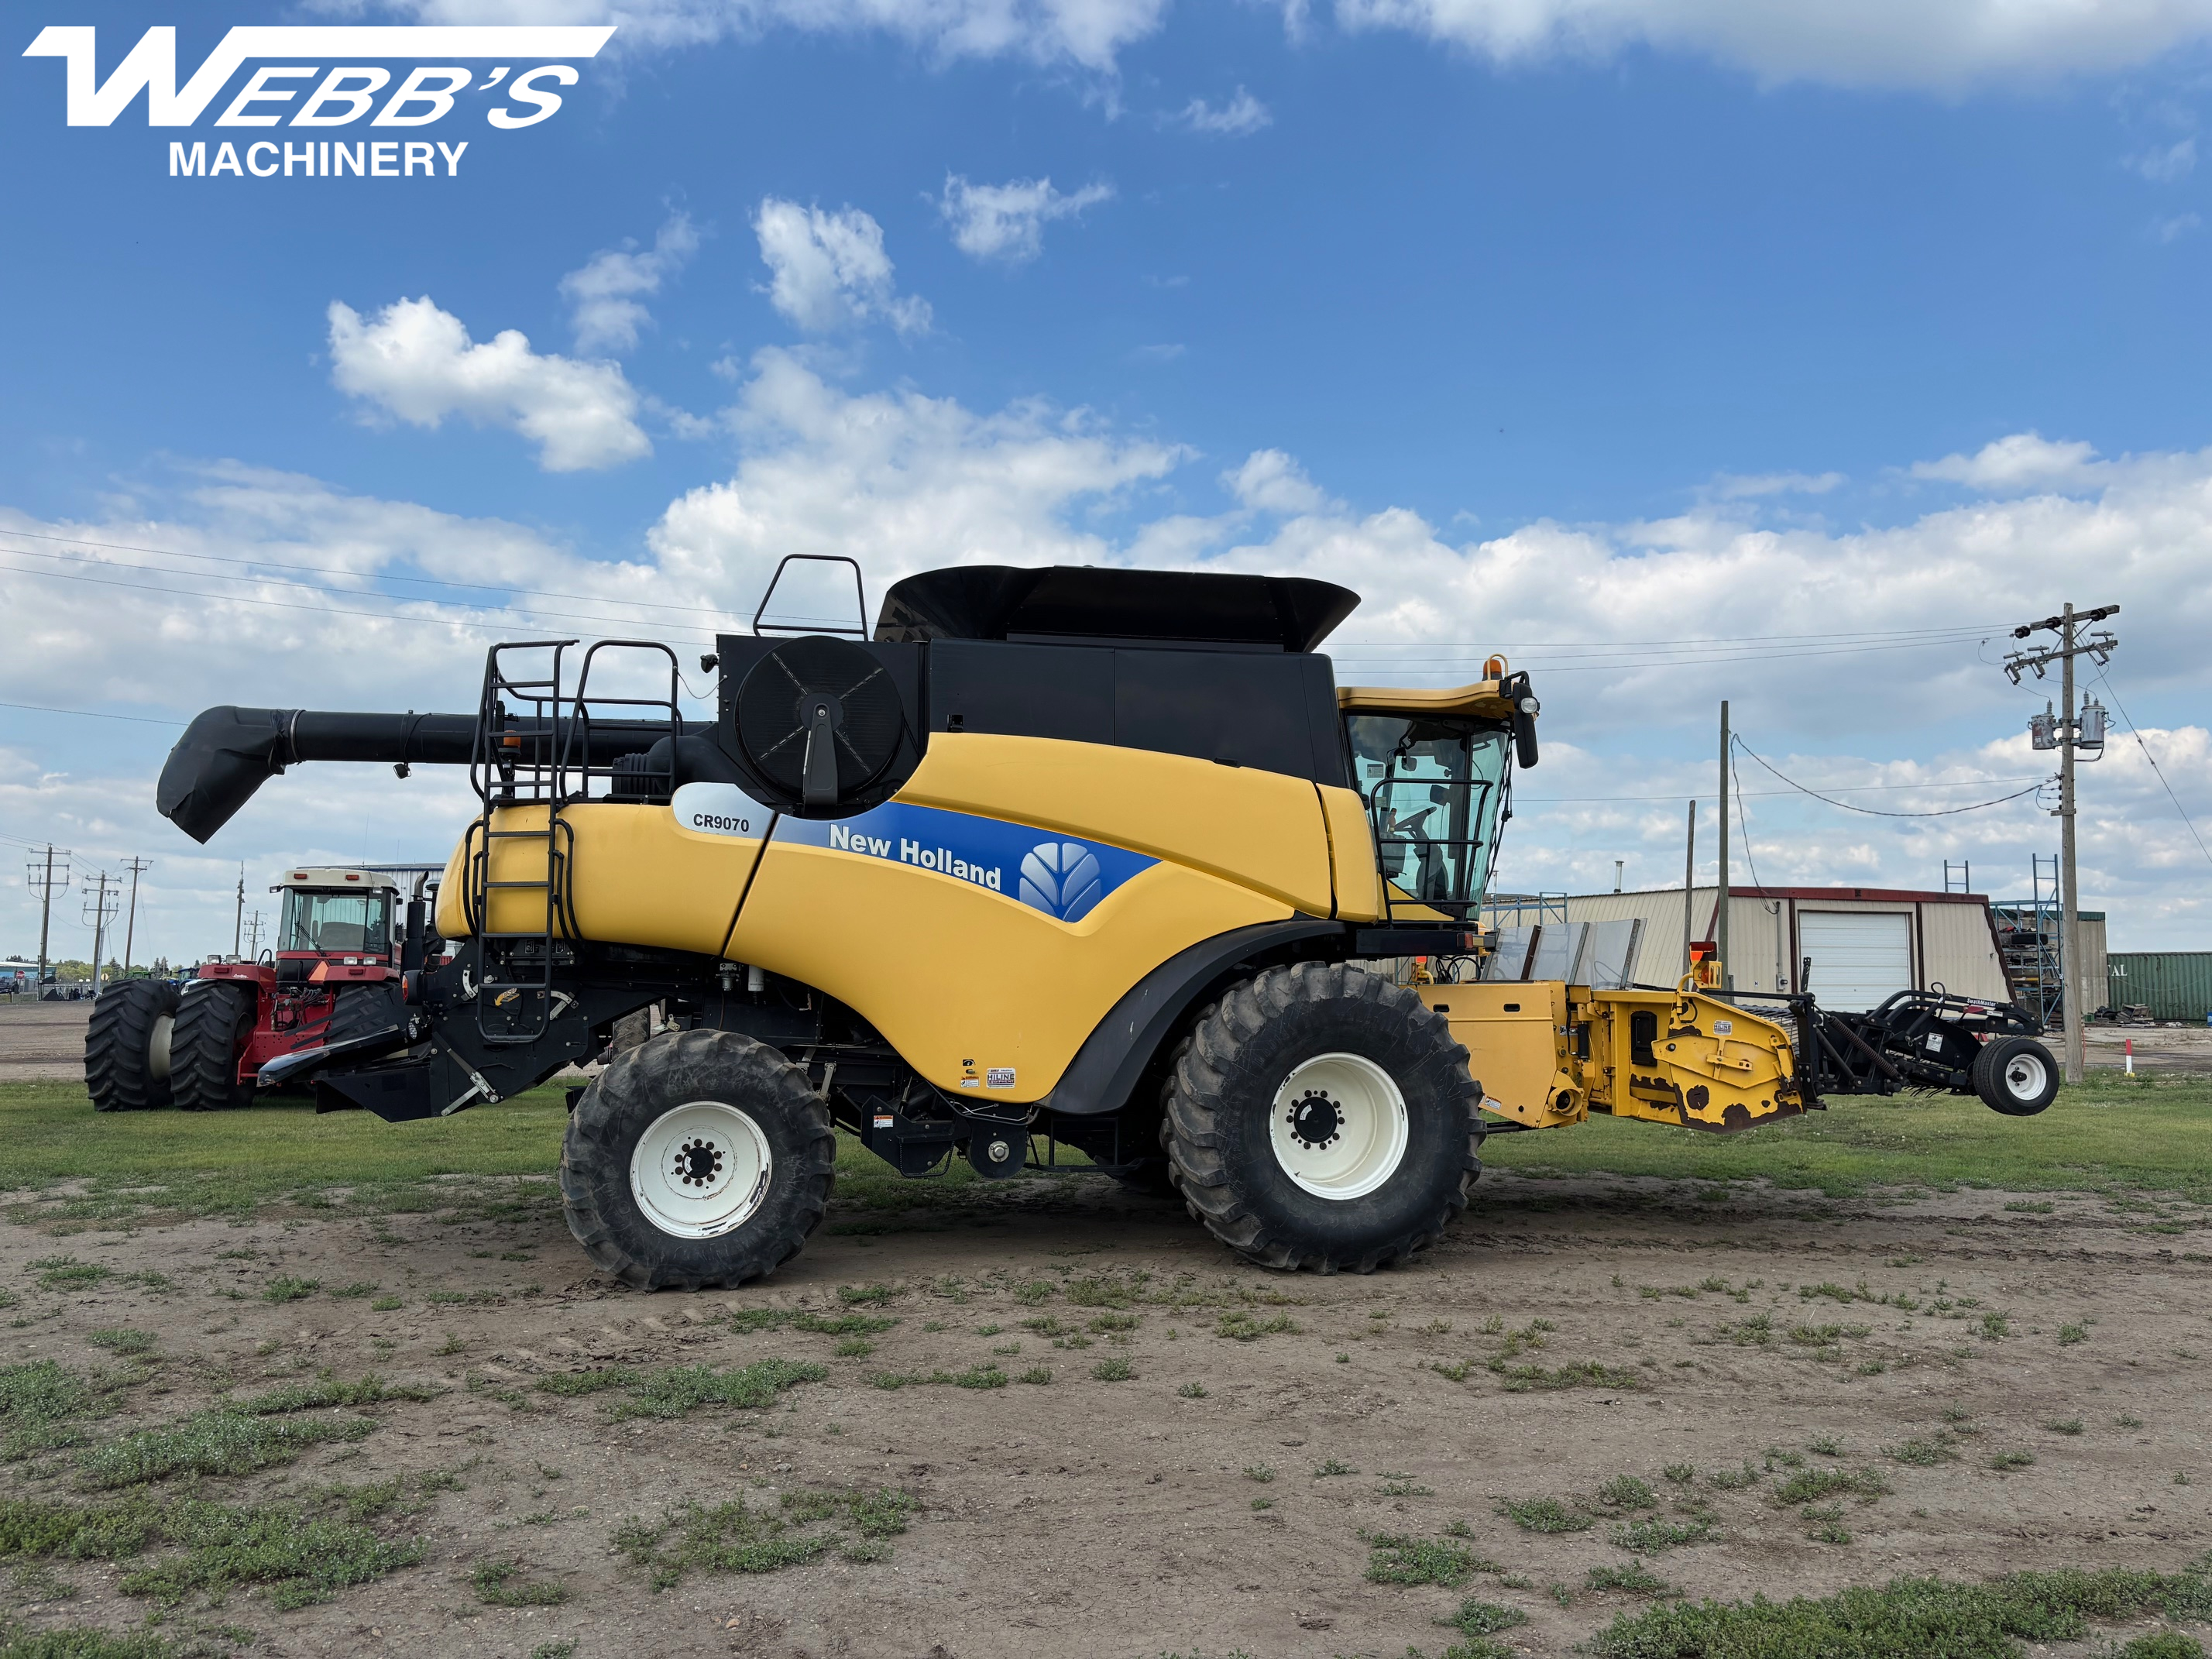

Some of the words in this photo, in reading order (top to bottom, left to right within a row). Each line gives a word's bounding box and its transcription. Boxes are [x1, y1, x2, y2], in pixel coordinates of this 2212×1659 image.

[693, 813, 750, 833] CR9070
[830, 823, 891, 857] New
[900, 837, 1001, 891] Holland
[1966, 998, 1996, 1007] SwathMaster
